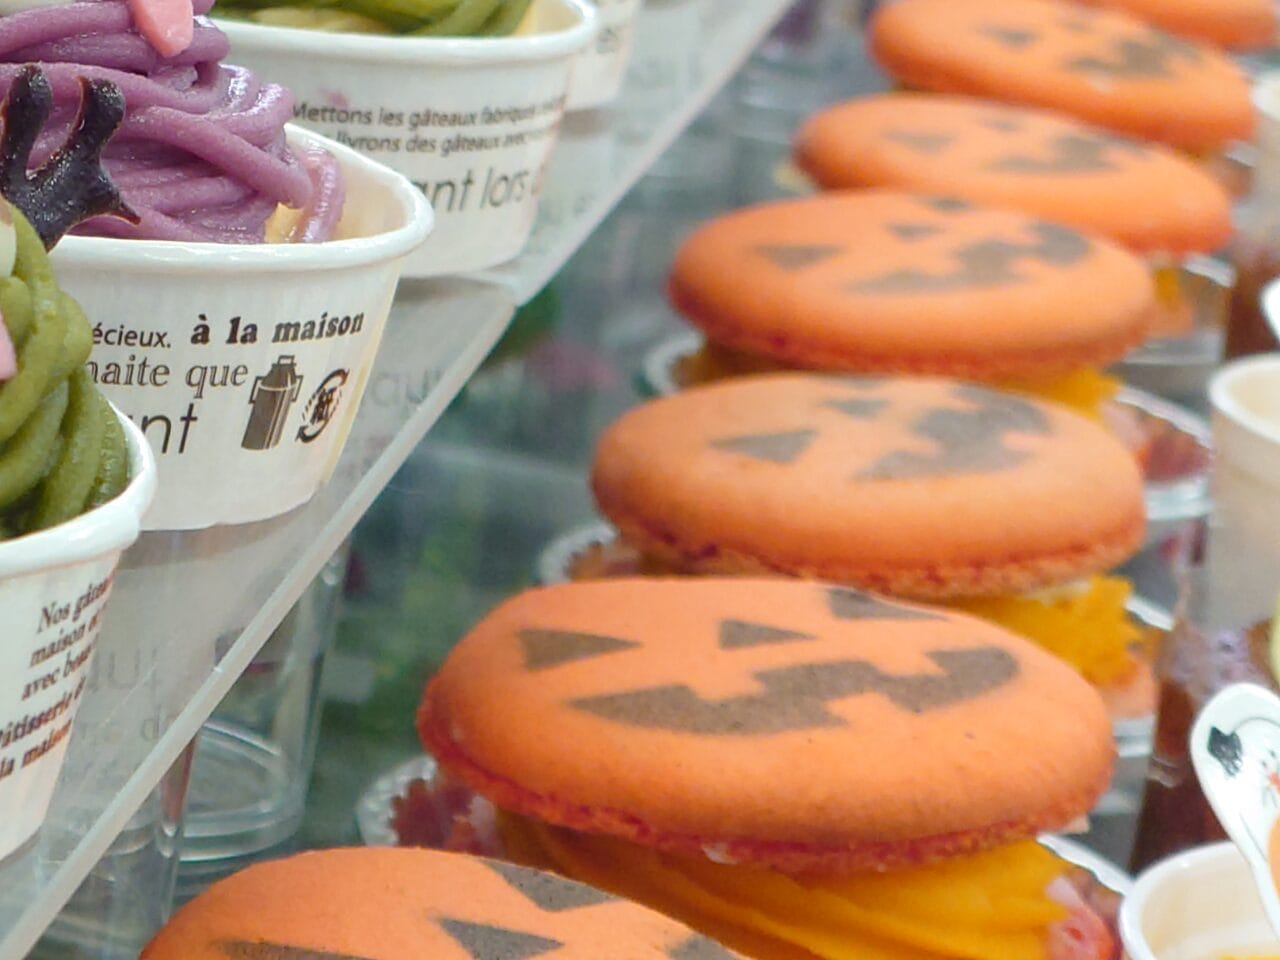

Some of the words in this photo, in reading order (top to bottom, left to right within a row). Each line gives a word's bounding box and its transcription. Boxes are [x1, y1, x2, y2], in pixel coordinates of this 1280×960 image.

[379, 107, 404, 127] les
[405, 133, 437, 152] des
[190, 313, 210, 345] à
[225, 316, 258, 344] la
[272, 312, 366, 343] maison
[185, 361, 249, 399] que
